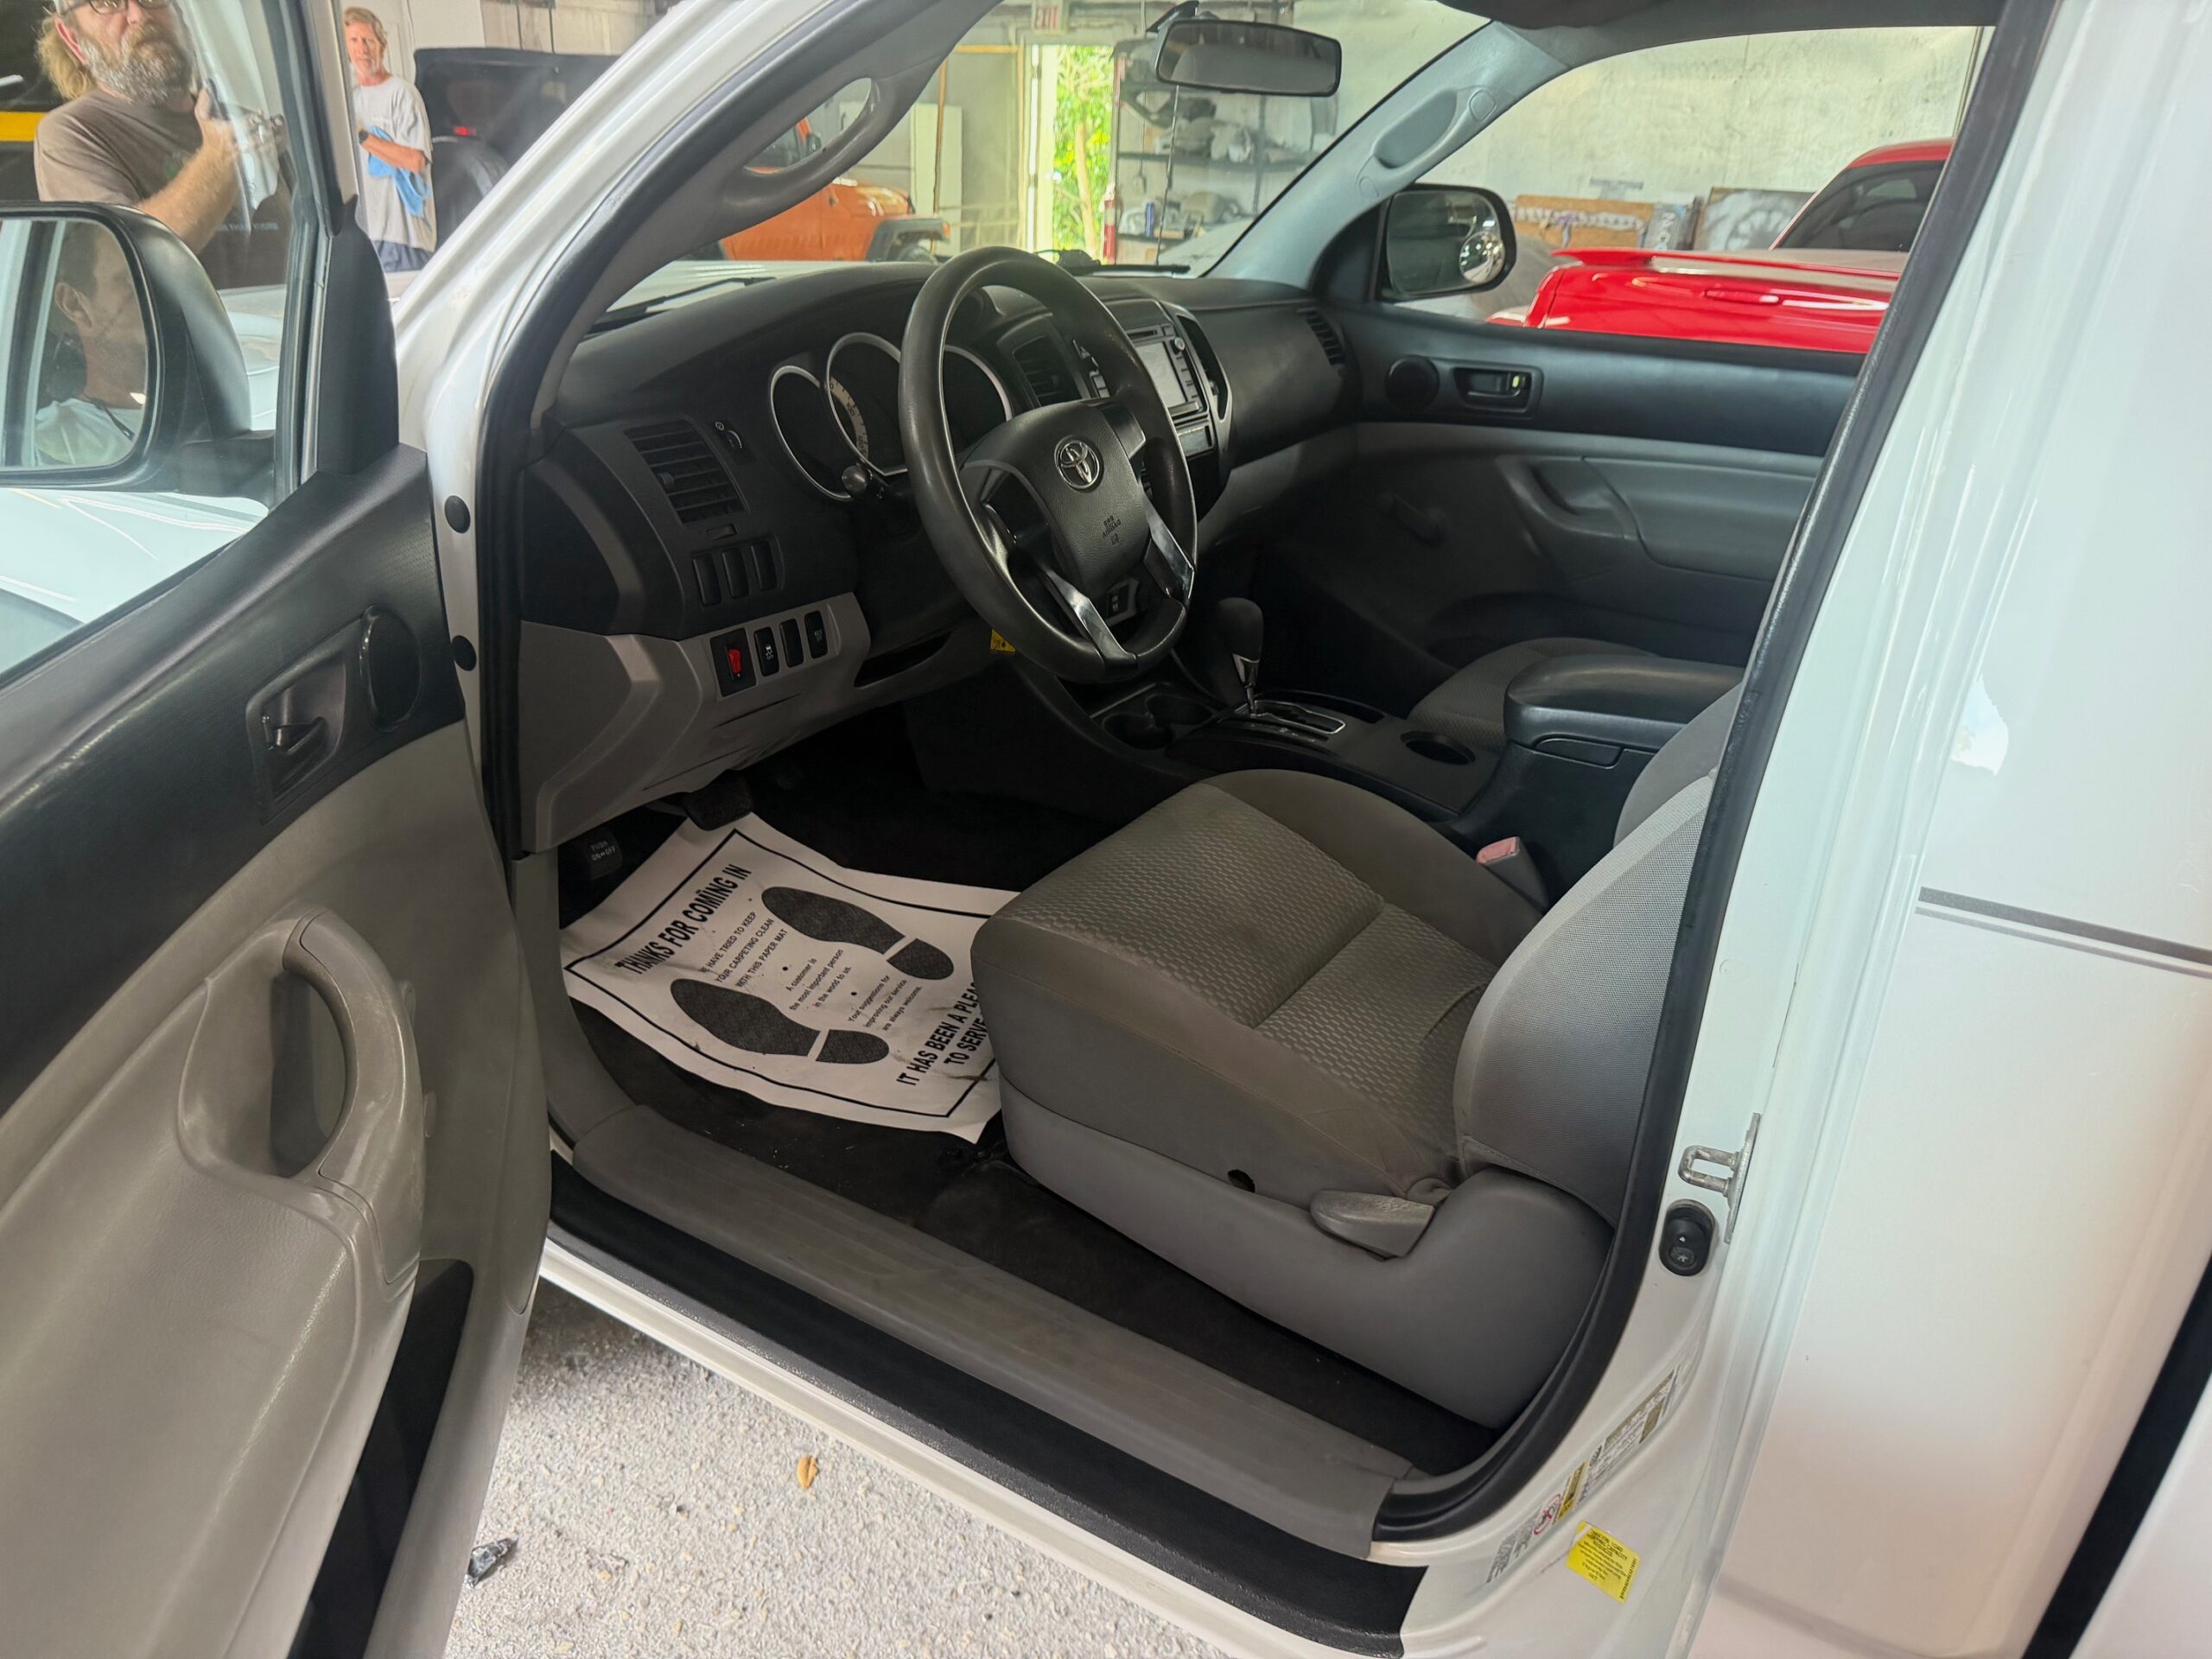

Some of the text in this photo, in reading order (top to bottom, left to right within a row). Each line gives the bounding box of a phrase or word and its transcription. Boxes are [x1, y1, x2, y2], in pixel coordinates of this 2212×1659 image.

[1033, 4, 1059, 30] EXIT
[614, 864, 752, 975] THANKS FOR COMING IN
[707, 949, 725, 969] HAVE
[719, 934, 740, 954] TRIED
[734, 926, 745, 938] TO
[742, 911, 758, 931] KEEP
[715, 918, 775, 983] YOUR CARPETING CLEAN
[735, 928, 789, 988] WITH THIS PAPER MAT
[791, 963, 812, 988] customer
[789, 949, 844, 1011] the most important person
[817, 993, 830, 1002] the
[826, 978, 841, 994] world
[847, 1009, 861, 1023] Your
[896, 982, 979, 1086] IT HAS BEEN A PLEA
[943, 1052, 969, 1065] TO
